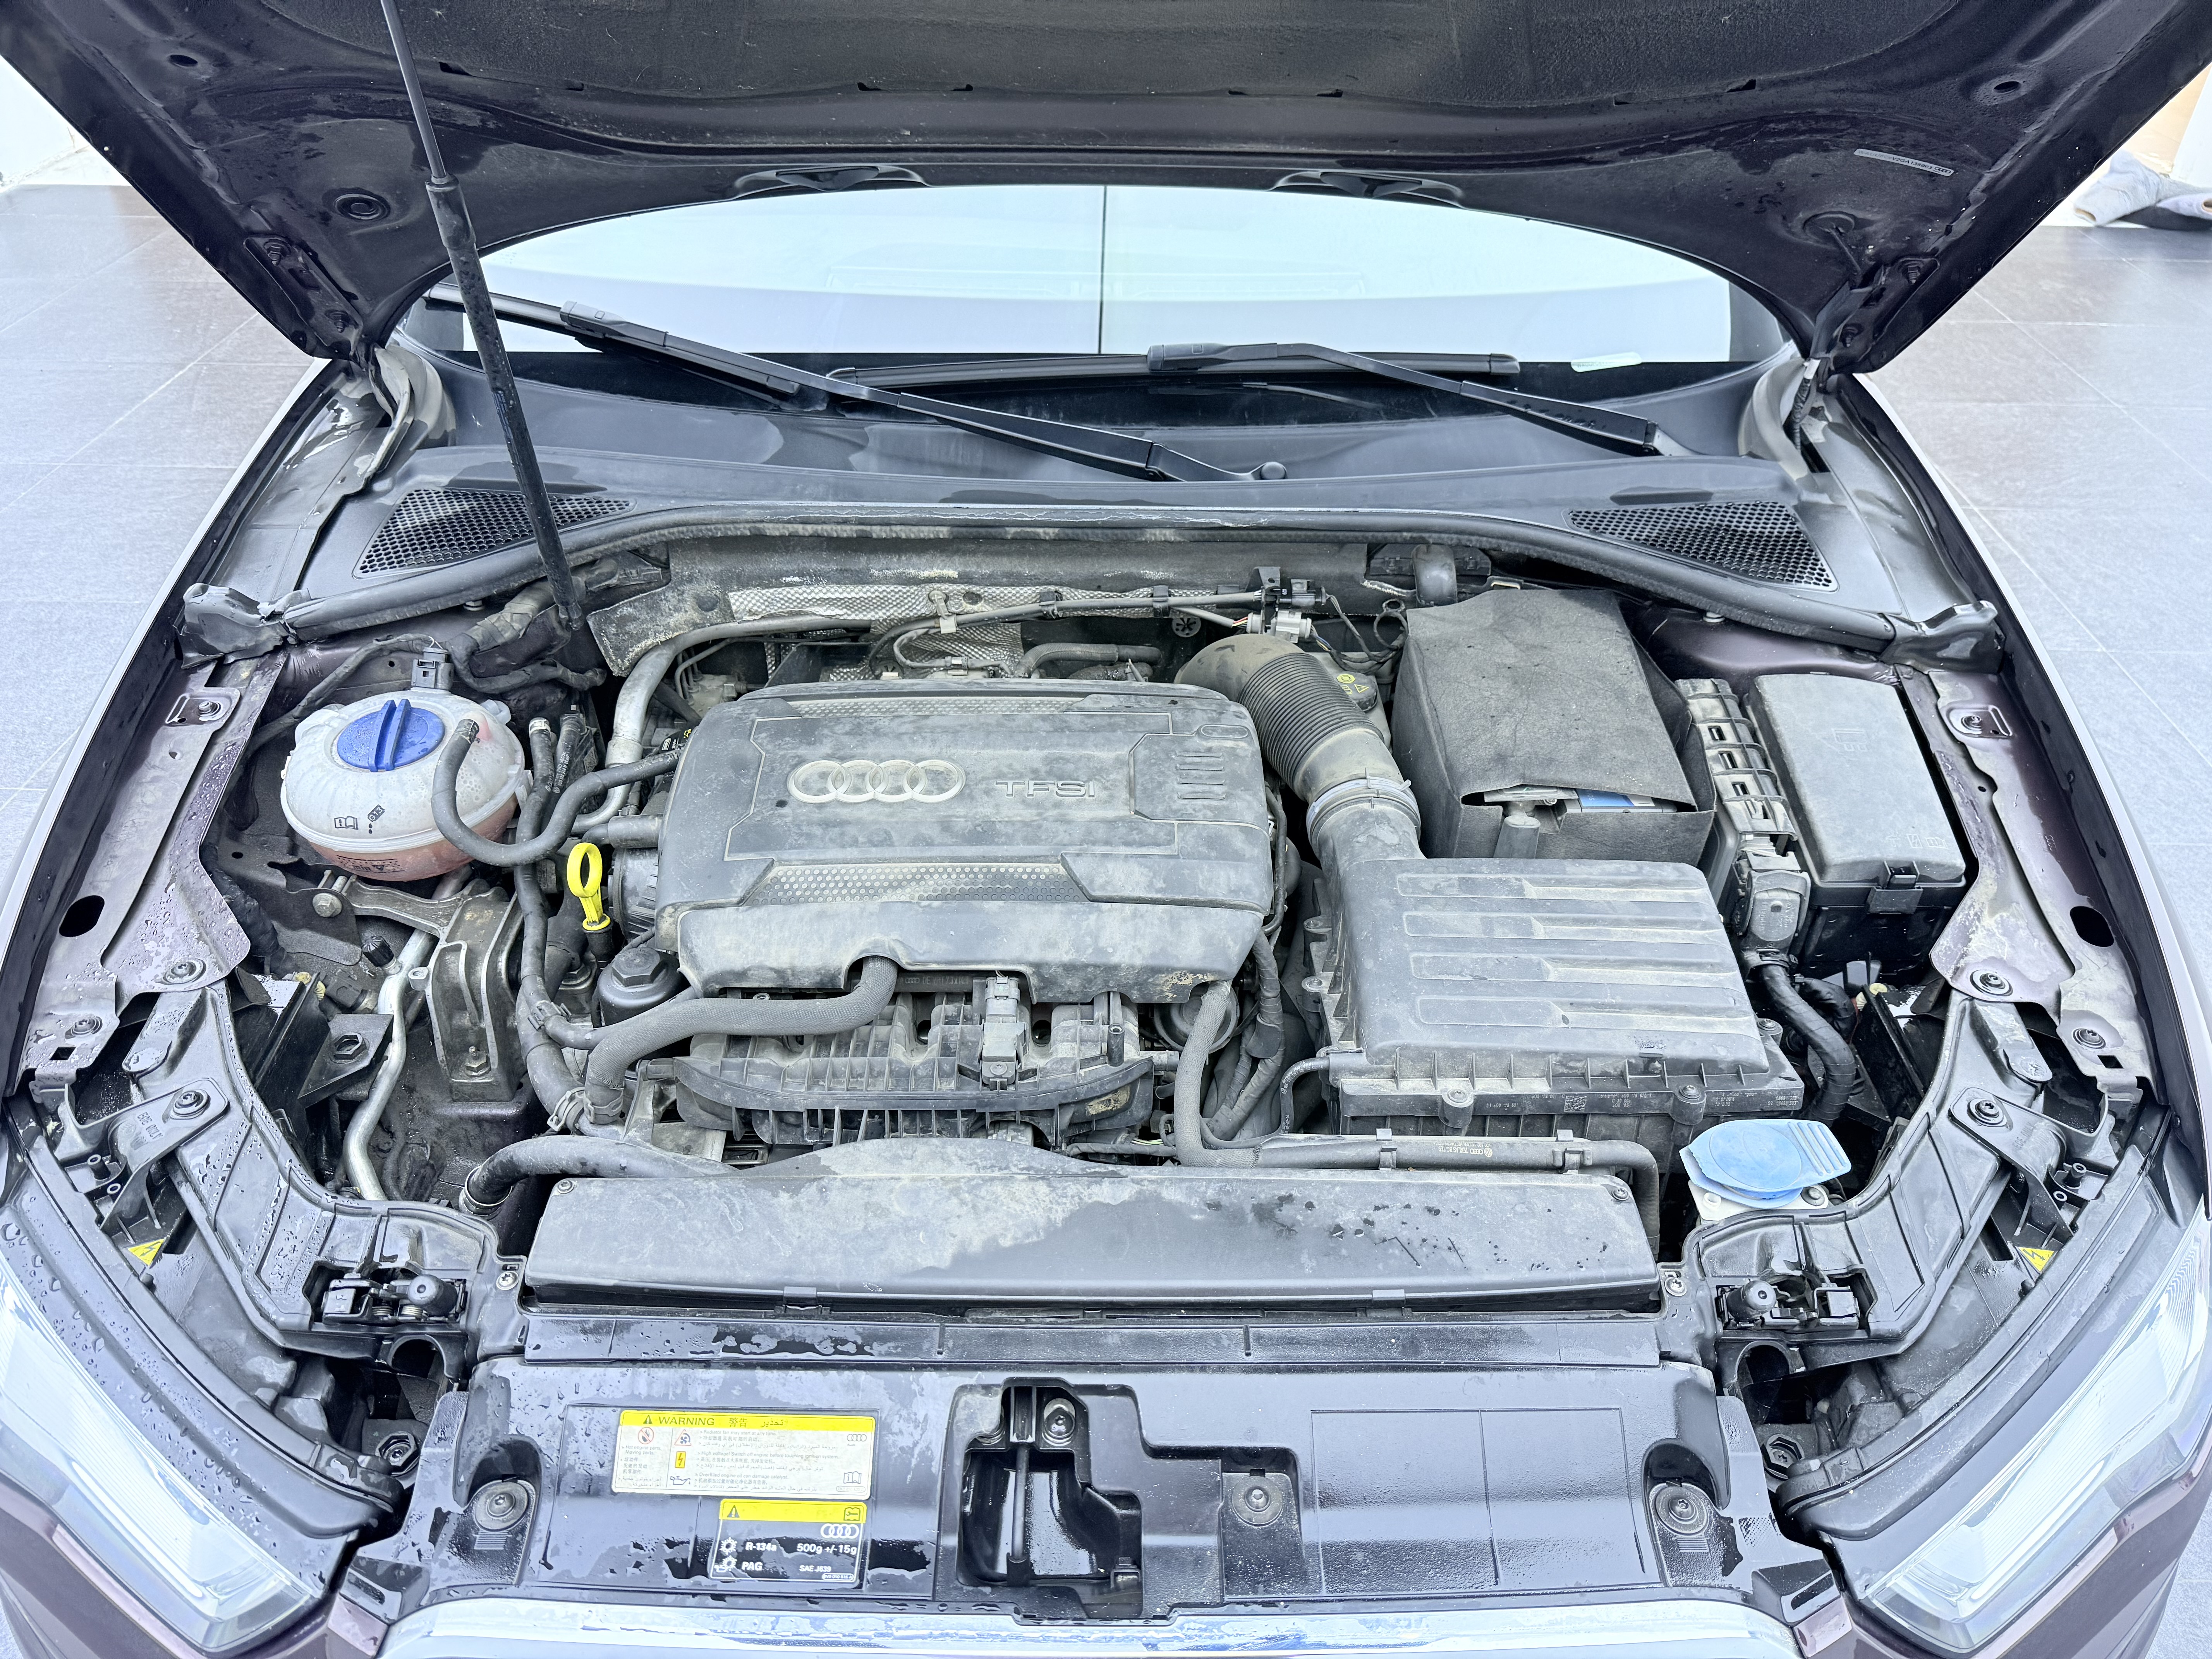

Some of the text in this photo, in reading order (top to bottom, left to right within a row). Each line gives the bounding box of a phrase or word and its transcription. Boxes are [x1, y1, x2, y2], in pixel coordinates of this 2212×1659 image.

[994, 780, 1096, 799] TFSI
[369, 807, 382, 821] G13
[137, 1112, 153, 1125] ECE
[146, 1124, 163, 1140] ONLY
[658, 1416, 715, 1426] WARNING
[729, 1417, 748, 1427] 警告
[760, 1418, 784, 1427] تحذير
[745, 1542, 857, 1555] R-134a 500g +/- 15g
[741, 1561, 763, 1571] PAG
